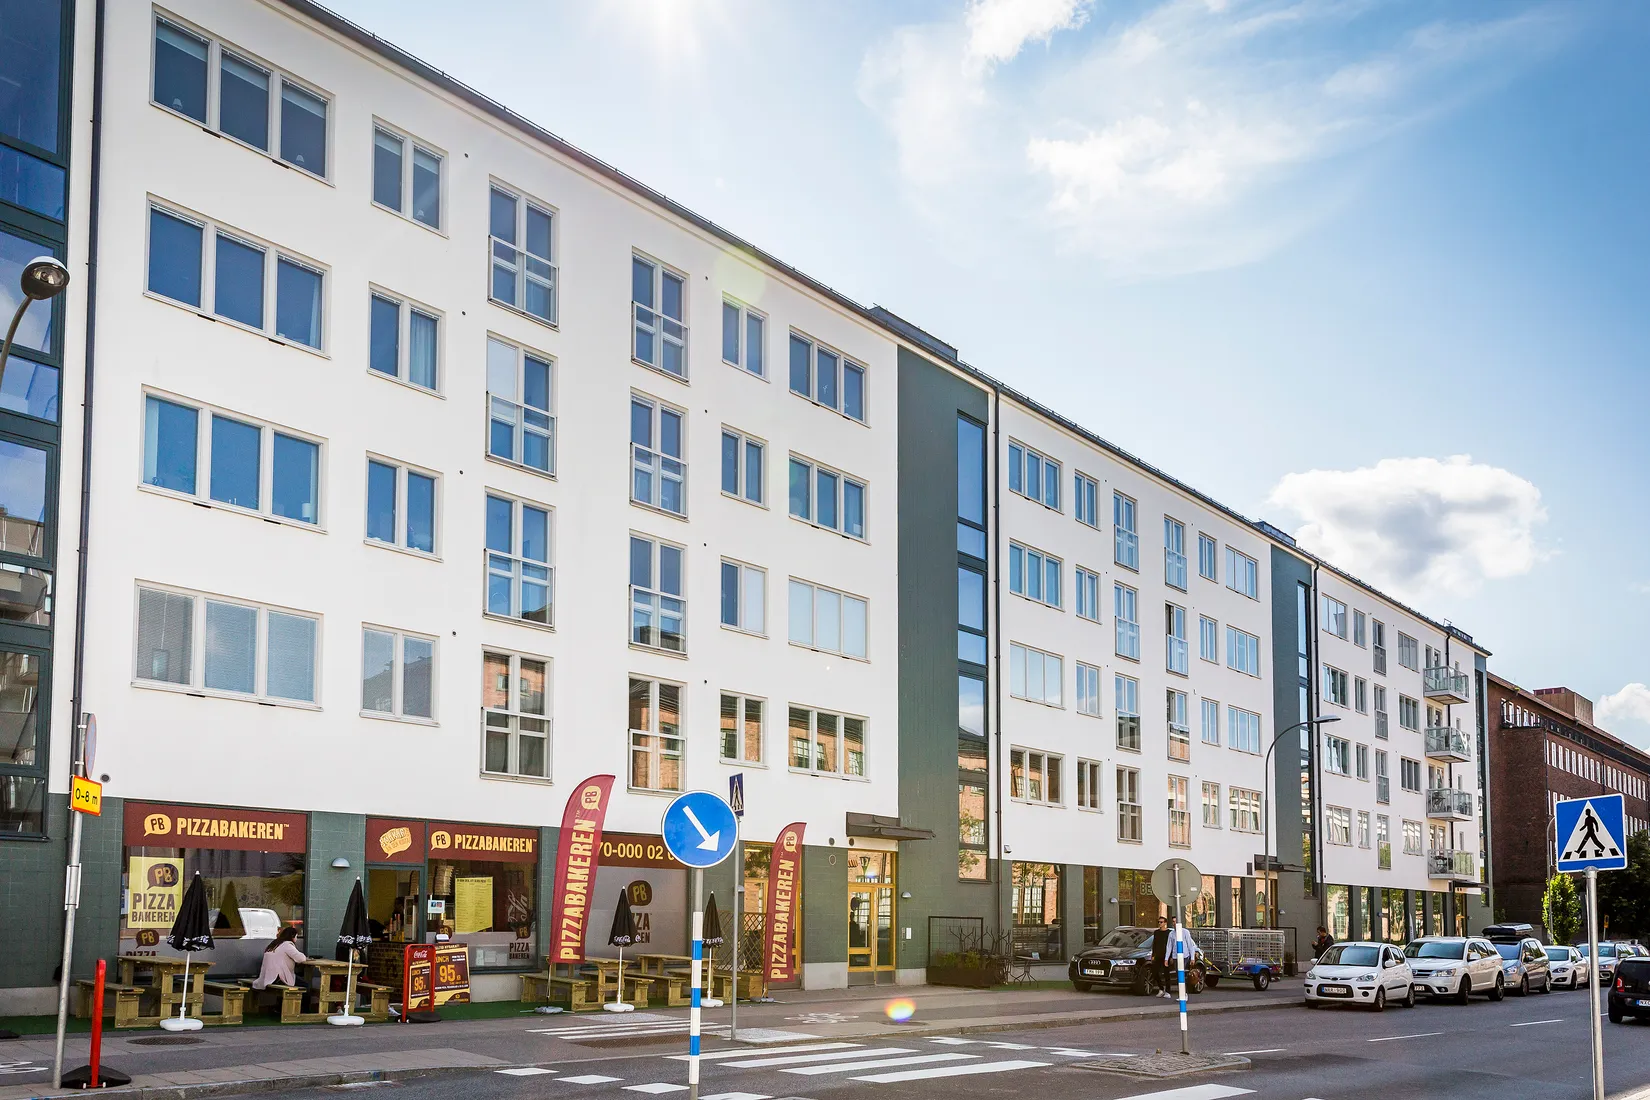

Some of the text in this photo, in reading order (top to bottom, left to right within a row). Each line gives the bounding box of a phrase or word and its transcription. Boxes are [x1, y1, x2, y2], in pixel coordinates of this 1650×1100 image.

[75, 787, 98, 806] 0-8 m
[584, 790, 598, 804] PB
[150, 817, 165, 831] PB
[435, 833, 447, 846] PB
[647, 844, 664, 860] 02
[154, 866, 173, 885] PB
[632, 883, 648, 903] PB
[132, 893, 176, 911] PIZZA
[131, 911, 176, 923] BAKEREN
[141, 931, 155, 945] PB
[509, 942, 530, 953] PIZZA
[439, 964, 456, 983] 95
[414, 976, 425, 991] 95
